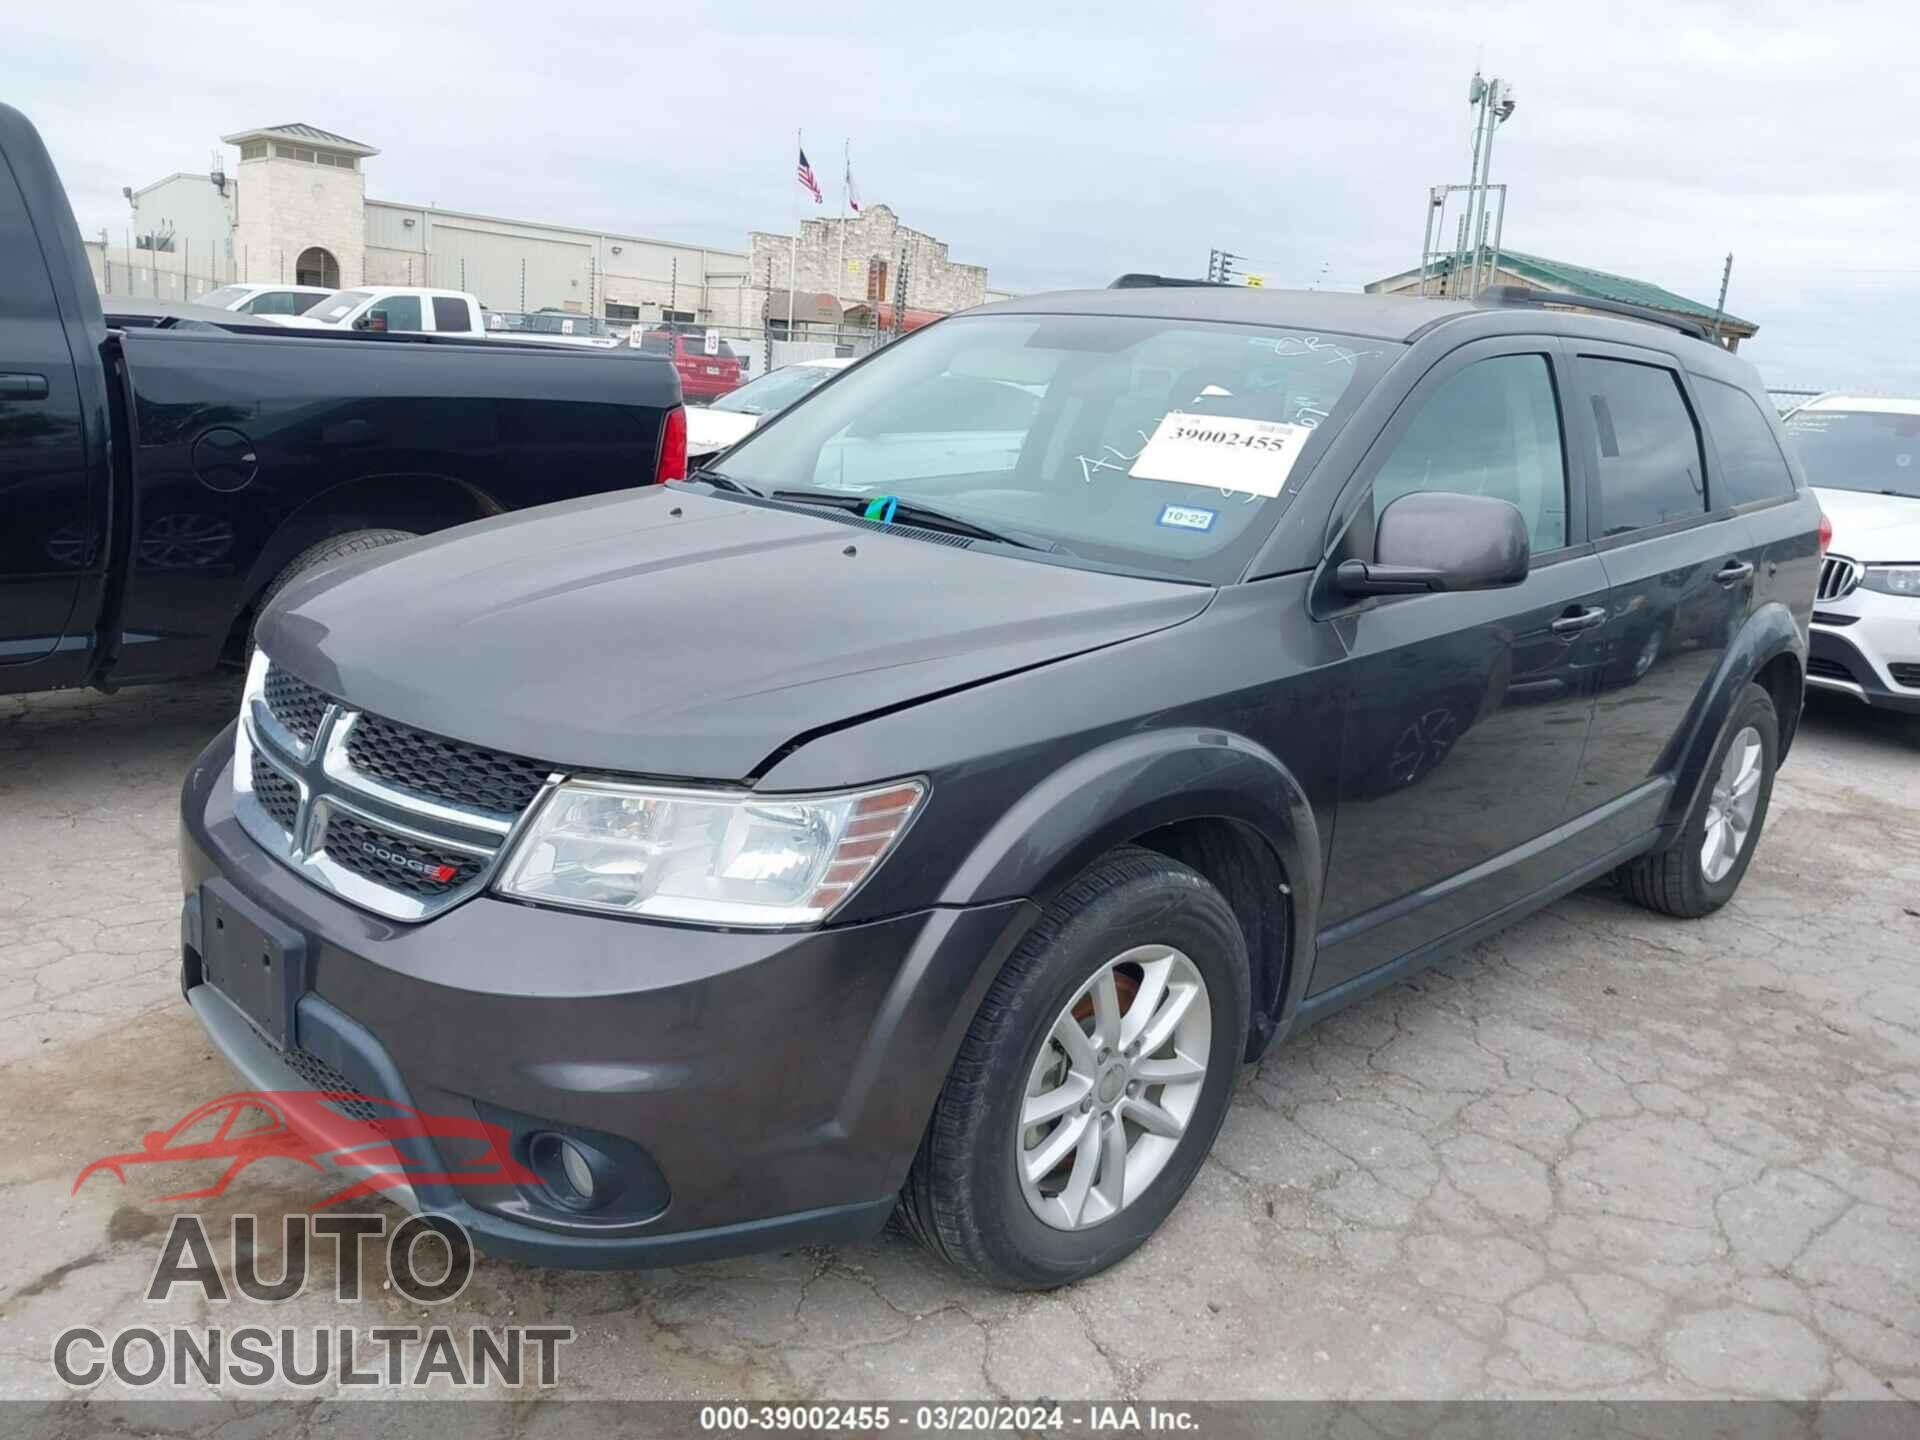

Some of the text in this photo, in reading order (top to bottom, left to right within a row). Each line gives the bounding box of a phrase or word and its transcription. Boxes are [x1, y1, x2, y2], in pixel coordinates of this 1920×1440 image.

[707, 335, 717, 350] 13
[1168, 427, 1285, 452] 39002455
[362, 841, 440, 876] DODGE
